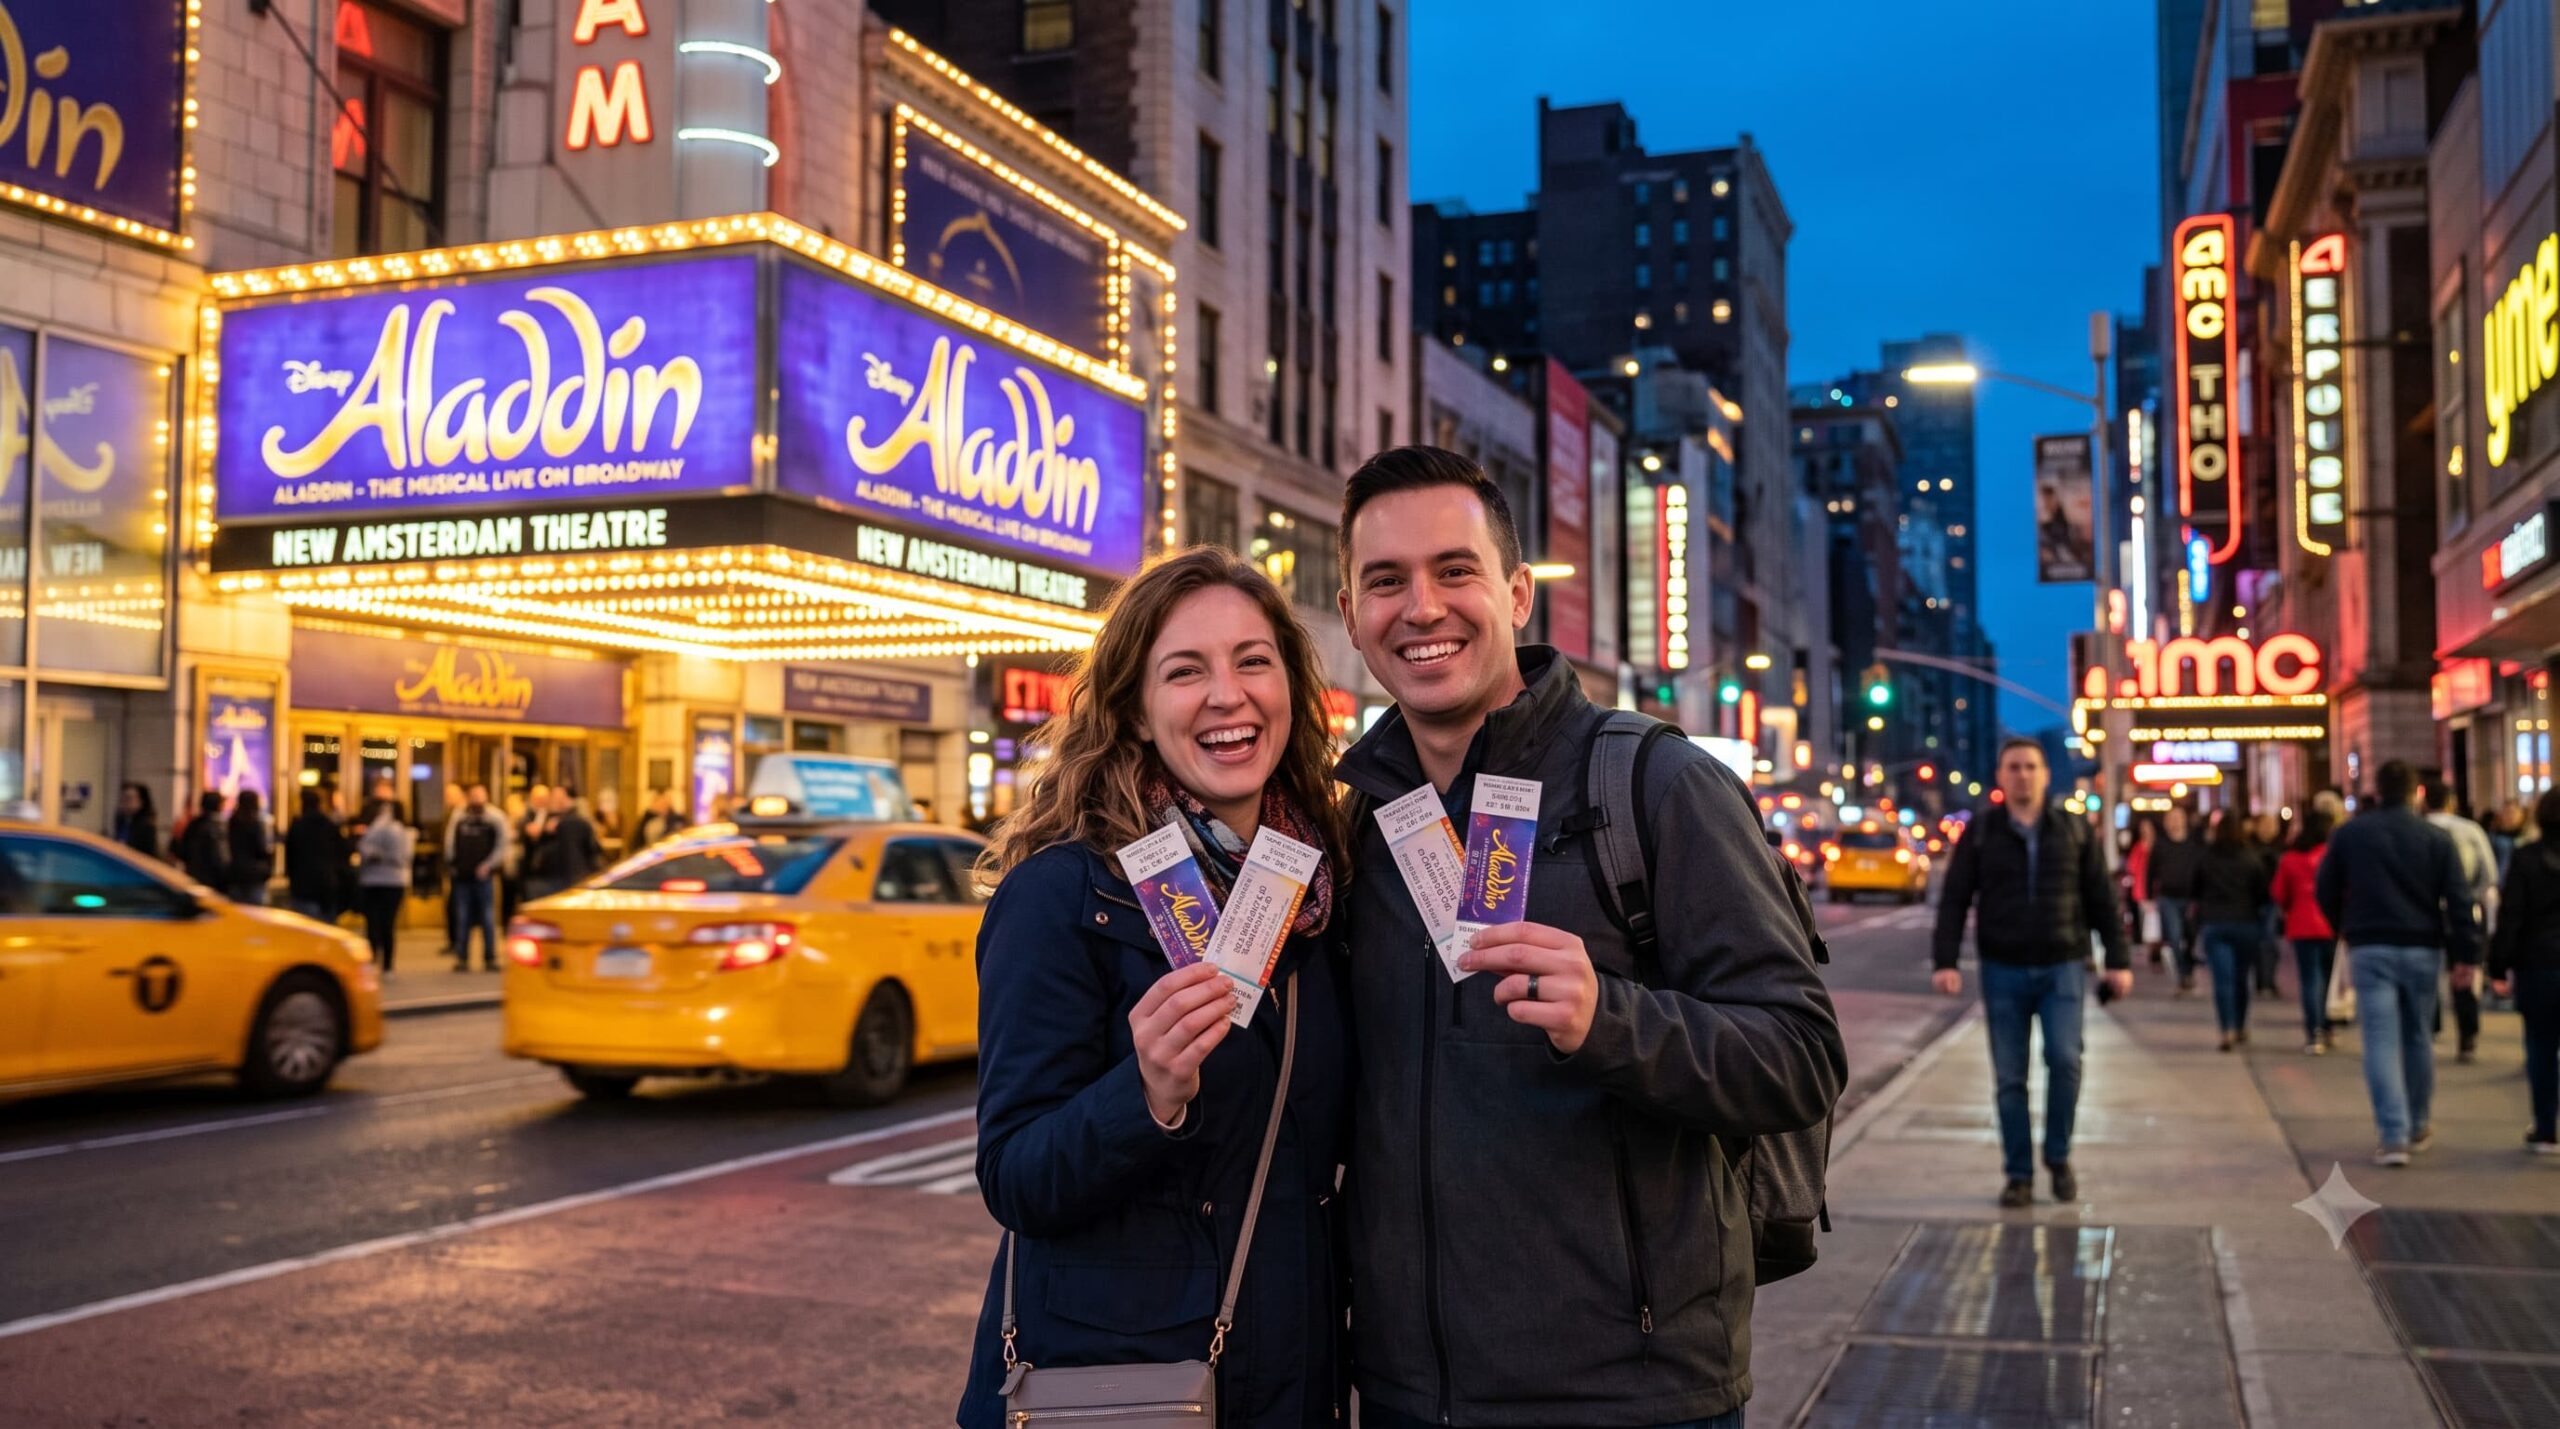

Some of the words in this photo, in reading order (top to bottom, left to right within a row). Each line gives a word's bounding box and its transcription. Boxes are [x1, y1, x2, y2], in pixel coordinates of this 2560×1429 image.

[261, 287, 702, 478] Aladdin
[846, 335, 1100, 534] Aladdin
[273, 480, 354, 504] ALADDIN
[368, 477, 403, 499] THE
[407, 473, 489, 496] MUSICAL
[492, 468, 536, 491] LIVE
[538, 467, 570, 488] ON
[573, 459, 684, 486] BROADWAY
[273, 528, 338, 566] NEW
[343, 517, 522, 562] AMSTERDAM
[529, 508, 668, 551] THEATRE
[857, 525, 905, 568] NEW
[906, 537, 1017, 593] AMSTERDAM
[1017, 562, 1088, 609] THEATRE
[395, 647, 533, 710] Aladdin
